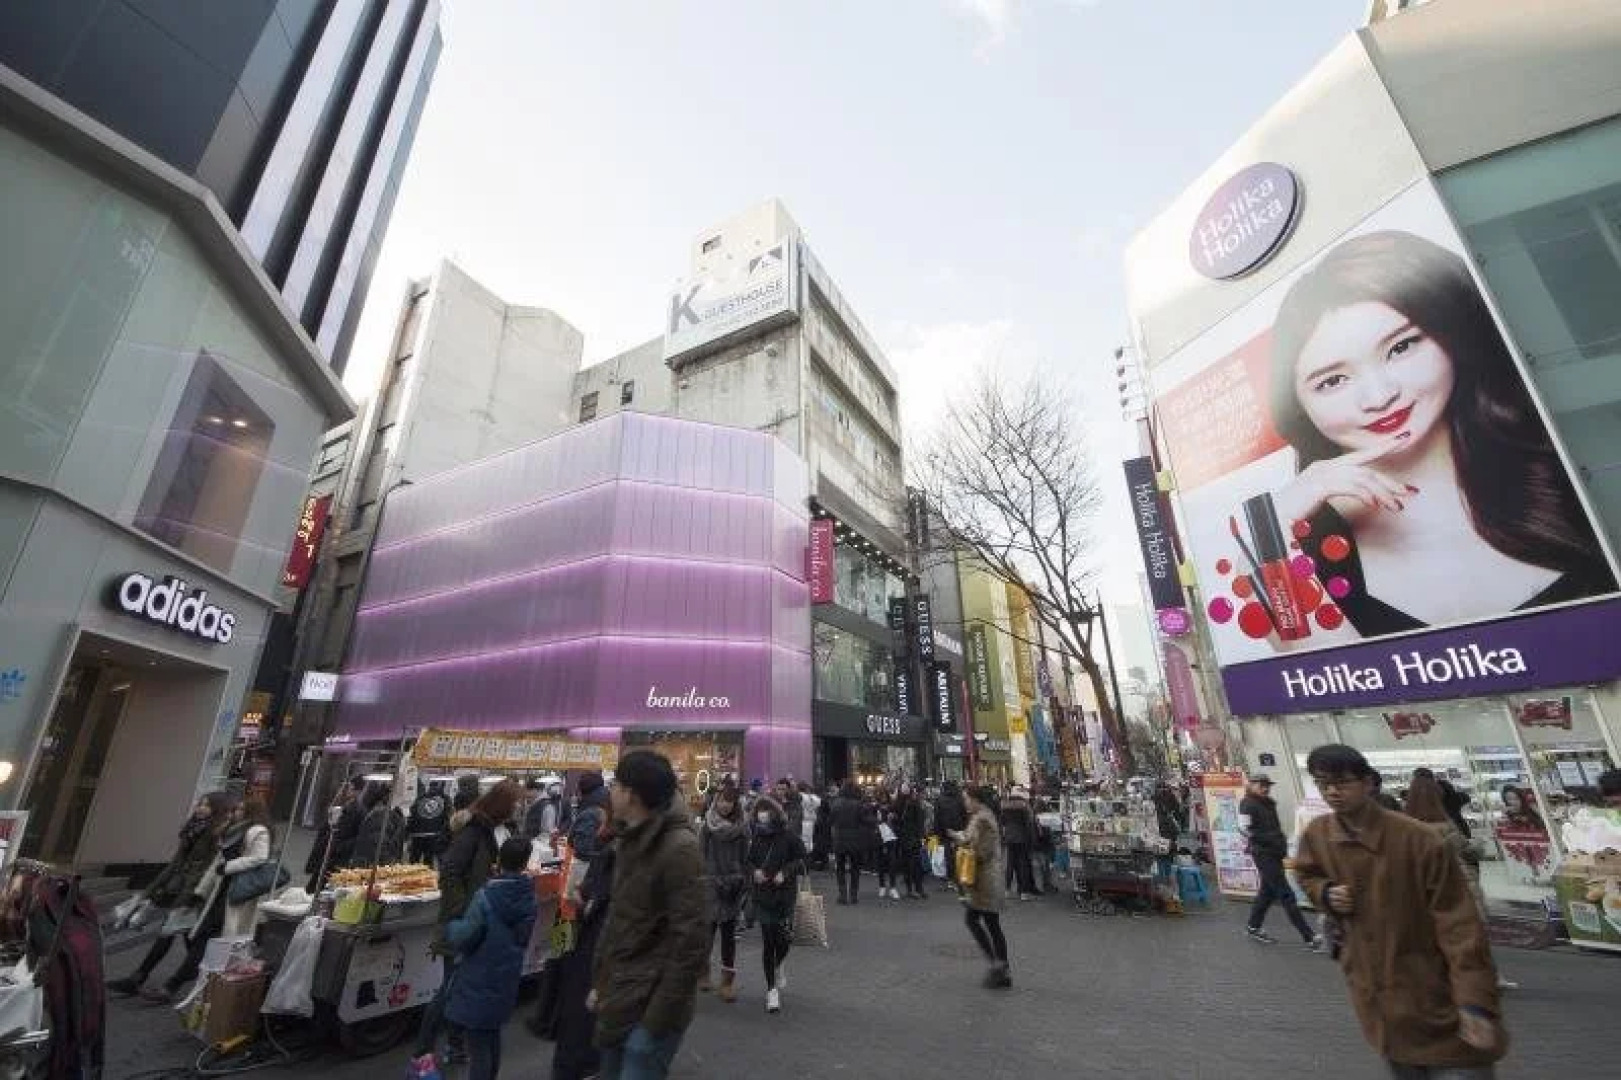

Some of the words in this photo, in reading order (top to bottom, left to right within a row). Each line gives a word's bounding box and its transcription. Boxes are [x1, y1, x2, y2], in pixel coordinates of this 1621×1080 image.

[1200, 180, 1274, 247] Holika
[1204, 199, 1284, 268] Holika
[670, 283, 701, 334] K
[1135, 482, 1157, 528] Holika
[1145, 530, 1168, 579] Holika
[119, 573, 236, 644] adidas
[917, 601, 932, 655] GUESS
[1282, 663, 1385, 698] Holika
[1391, 643, 1527, 686] Holika
[646, 686, 705, 708] banila
[866, 714, 901, 735] GUESS
